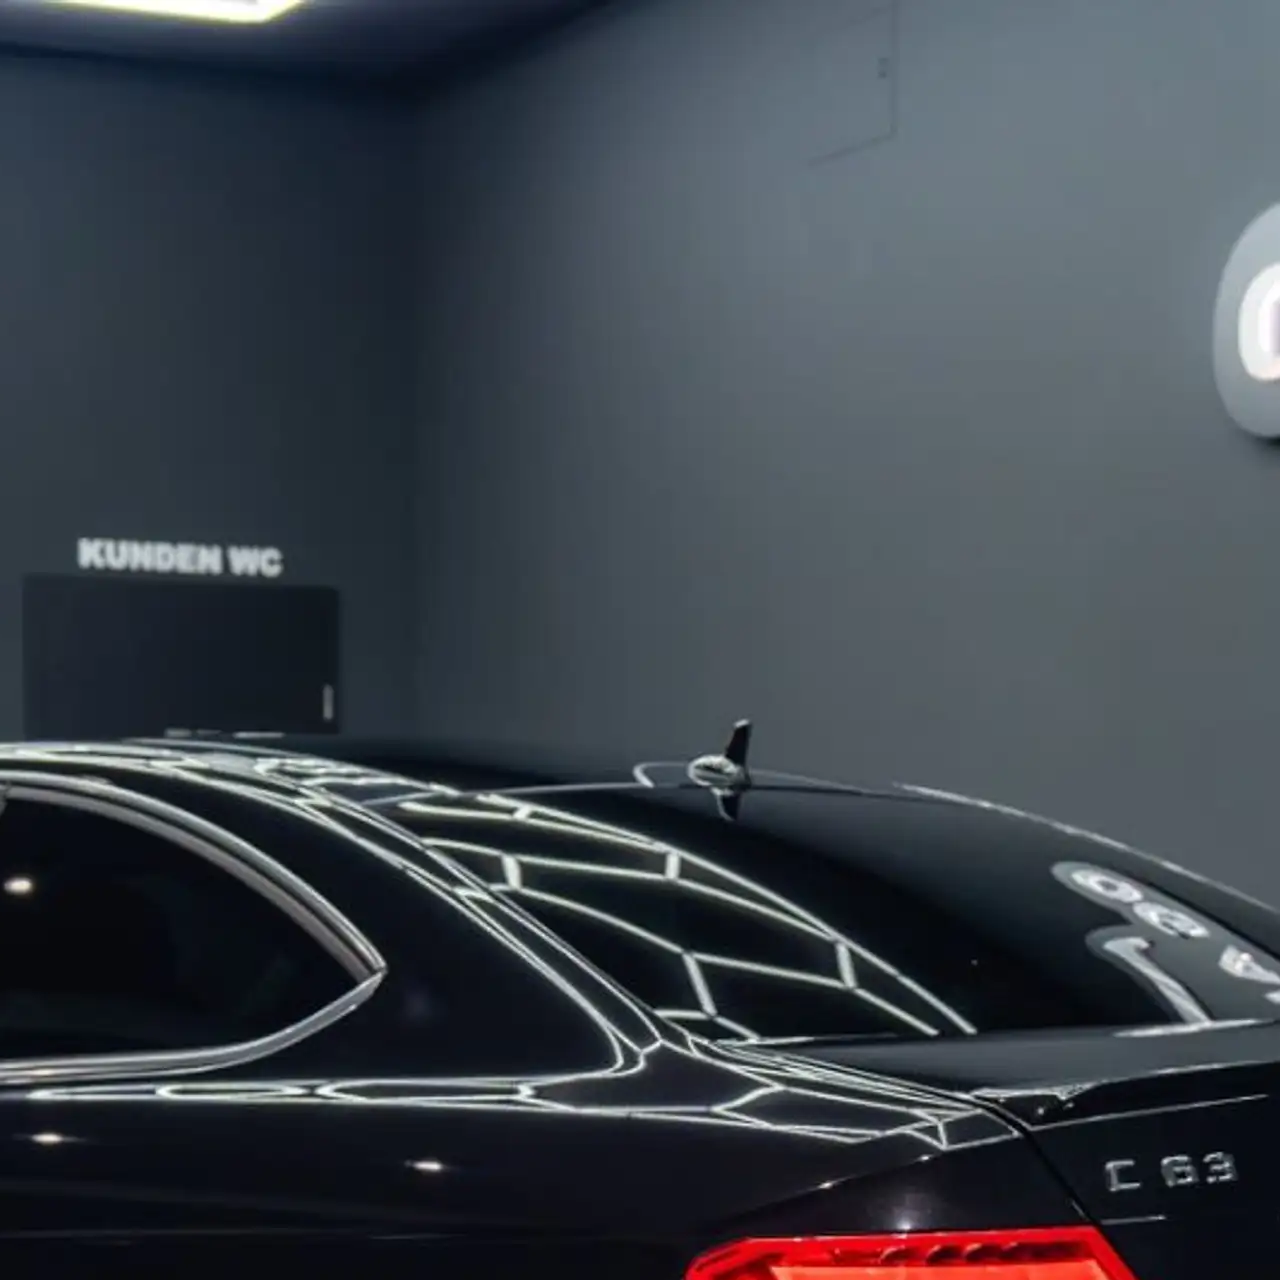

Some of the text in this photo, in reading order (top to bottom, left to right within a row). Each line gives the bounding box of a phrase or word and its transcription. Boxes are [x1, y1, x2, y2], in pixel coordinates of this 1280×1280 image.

[78, 537, 284, 578] KUNDEN WC
[1105, 1151, 1237, 1192] C 63
